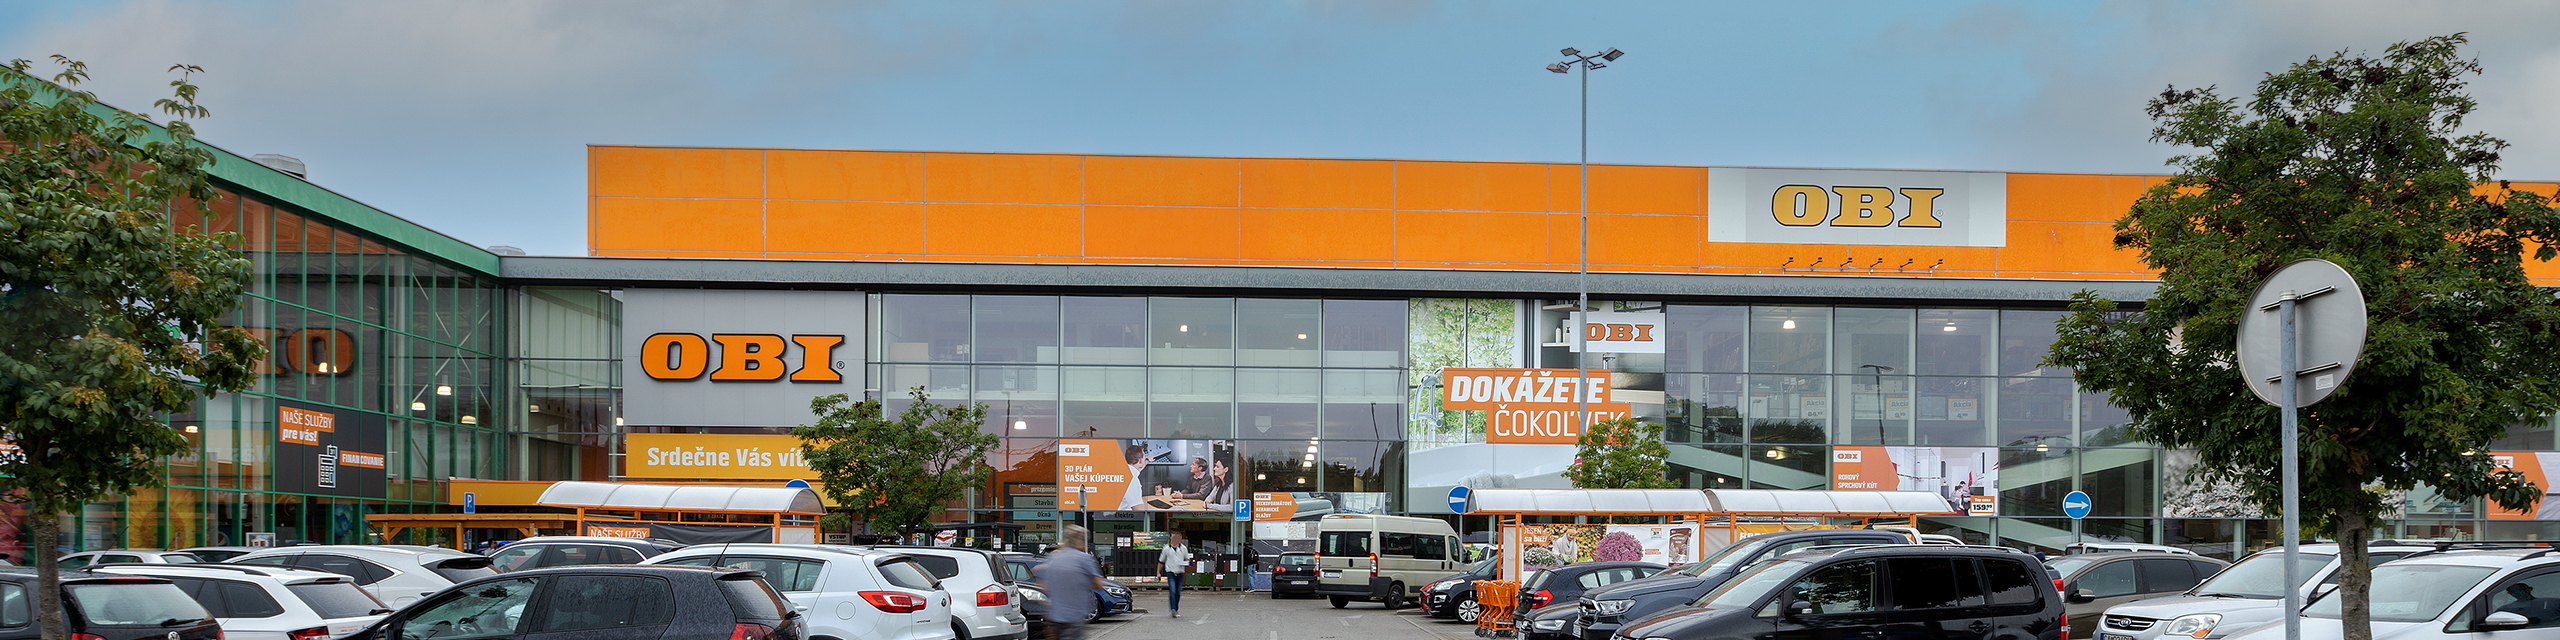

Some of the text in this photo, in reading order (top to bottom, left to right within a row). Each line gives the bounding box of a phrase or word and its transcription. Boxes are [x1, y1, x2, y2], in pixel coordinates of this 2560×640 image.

[1772, 184, 1944, 228] OBI
[1585, 323, 1654, 342] OBI
[641, 332, 845, 383] OBI
[1451, 371, 1605, 403] DOKÁŽETE
[282, 410, 333, 429] NAŠE SLUŽBY
[282, 429, 317, 442] pre vás!
[342, 453, 384, 467] FINANCOVANIE
[647, 446, 730, 467] Srdečne
[736, 447, 772, 467] Vás
[1075, 464, 1093, 472] PLÁN
[1064, 473, 1088, 482] VAŠEJ
[1837, 481, 1866, 489] SPRCHOVÝ
[467, 494, 473, 508] P
[1239, 502, 1246, 513] P
[590, 528, 648, 539] NAŠE SLUŽBY
